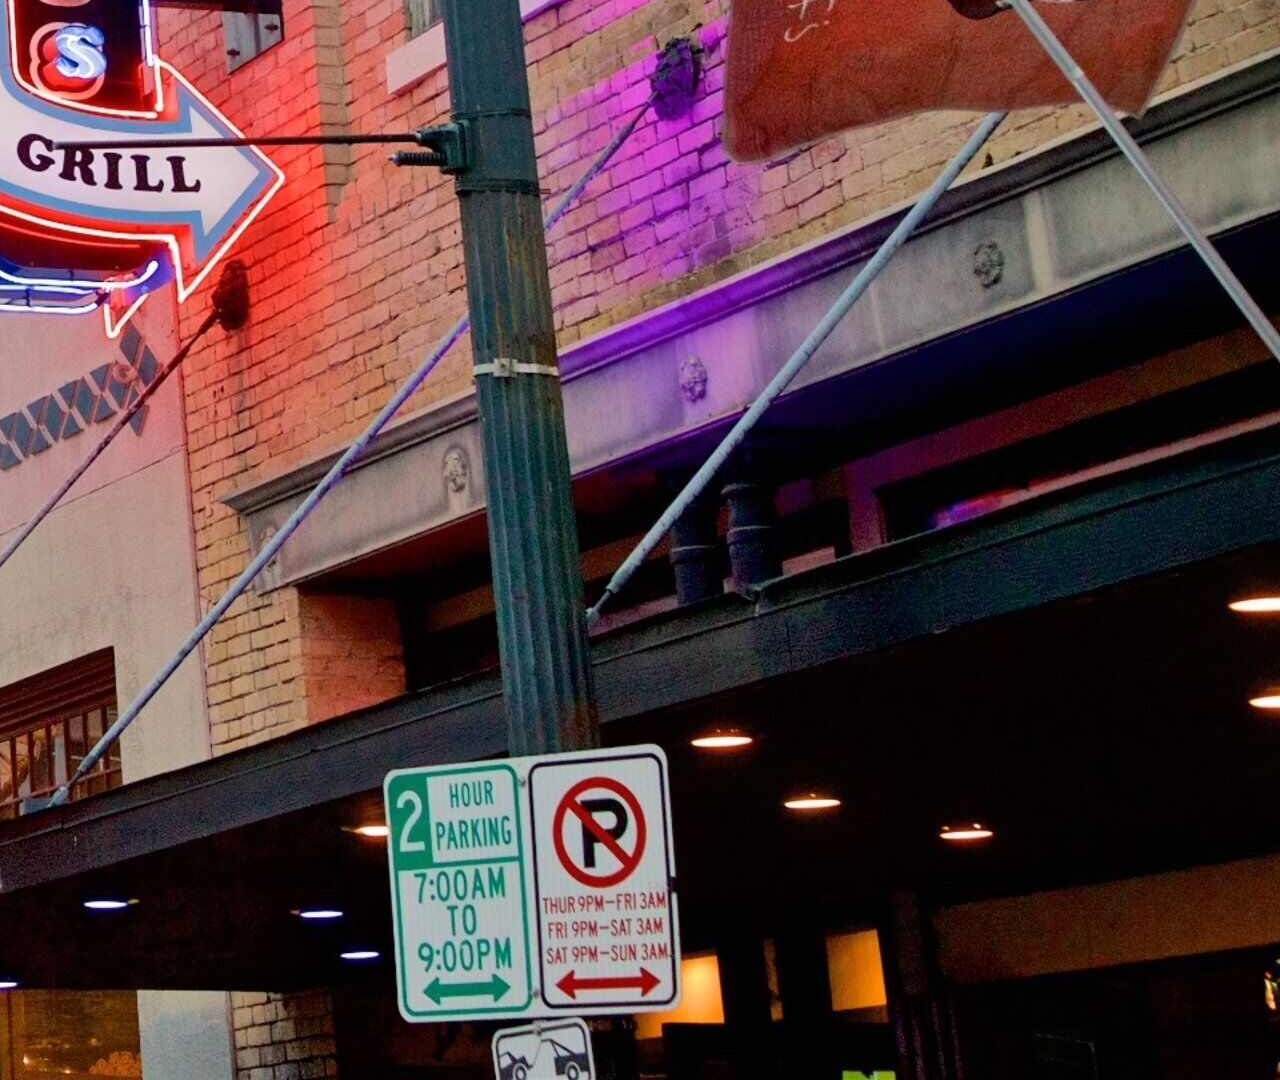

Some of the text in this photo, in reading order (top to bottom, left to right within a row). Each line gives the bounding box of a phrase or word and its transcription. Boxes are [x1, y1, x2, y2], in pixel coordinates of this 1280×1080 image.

[16, 132, 202, 193] GRILL
[448, 780, 494, 808] HOUR
[396, 789, 426, 853] 2
[435, 815, 512, 851] PARKING
[413, 867, 506, 903] 7:00AM
[543, 896, 577, 914] THUR
[639, 891, 667, 909] 3AM
[446, 904, 477, 936] TO
[547, 922, 568, 939] FRI
[636, 917, 664, 935] 3AM
[417, 936, 513, 972] 9:00PM
[546, 946, 568, 965] SAT
[640, 943, 668, 960] 3AM
